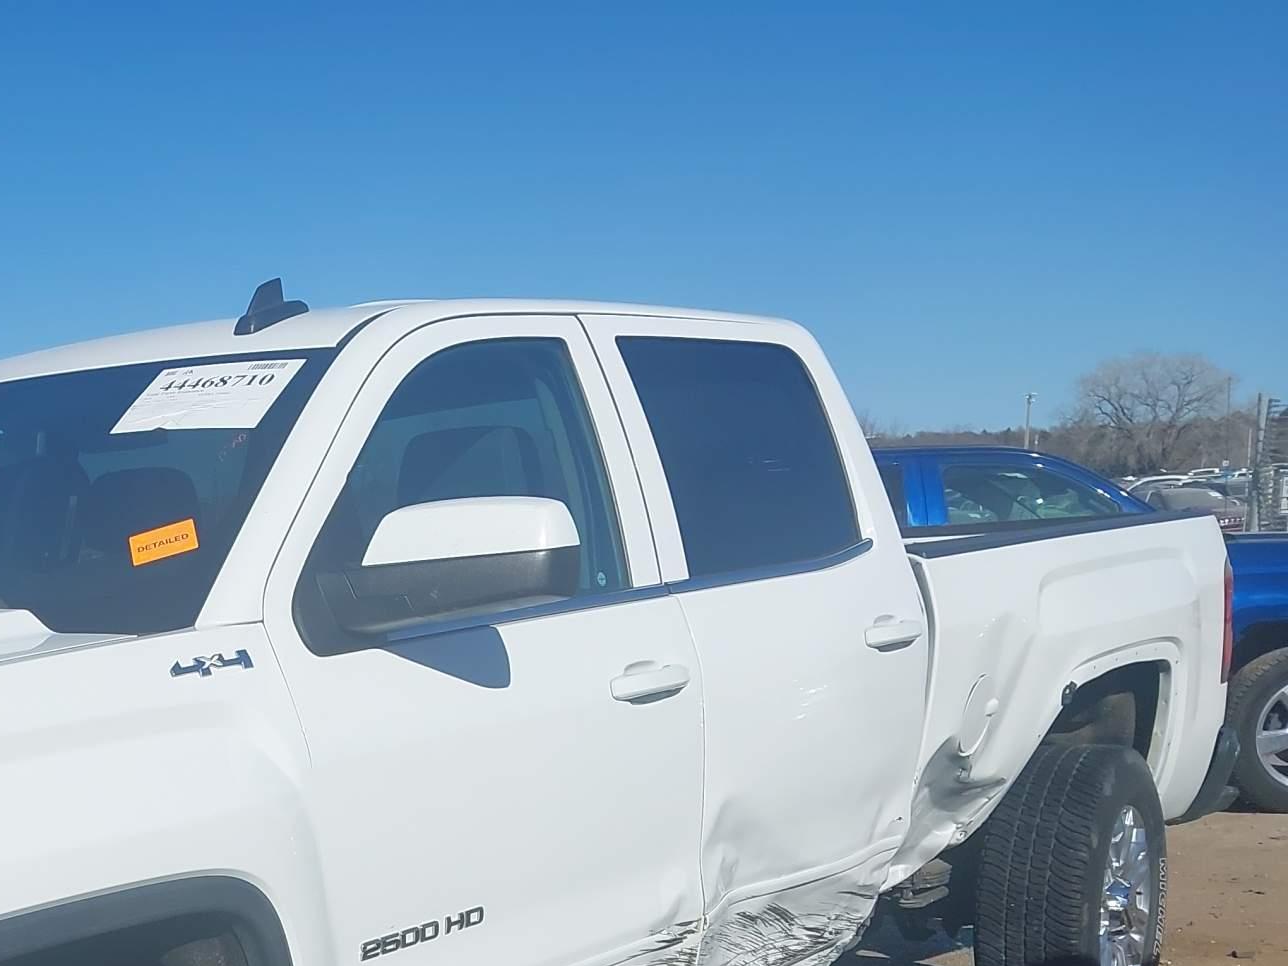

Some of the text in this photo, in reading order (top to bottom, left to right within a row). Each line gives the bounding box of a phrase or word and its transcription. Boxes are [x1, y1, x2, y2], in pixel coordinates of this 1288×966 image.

[160, 373, 275, 391] 44468710
[137, 533, 189, 552] DETAILED
[360, 906, 484, 962] 2500 HD
